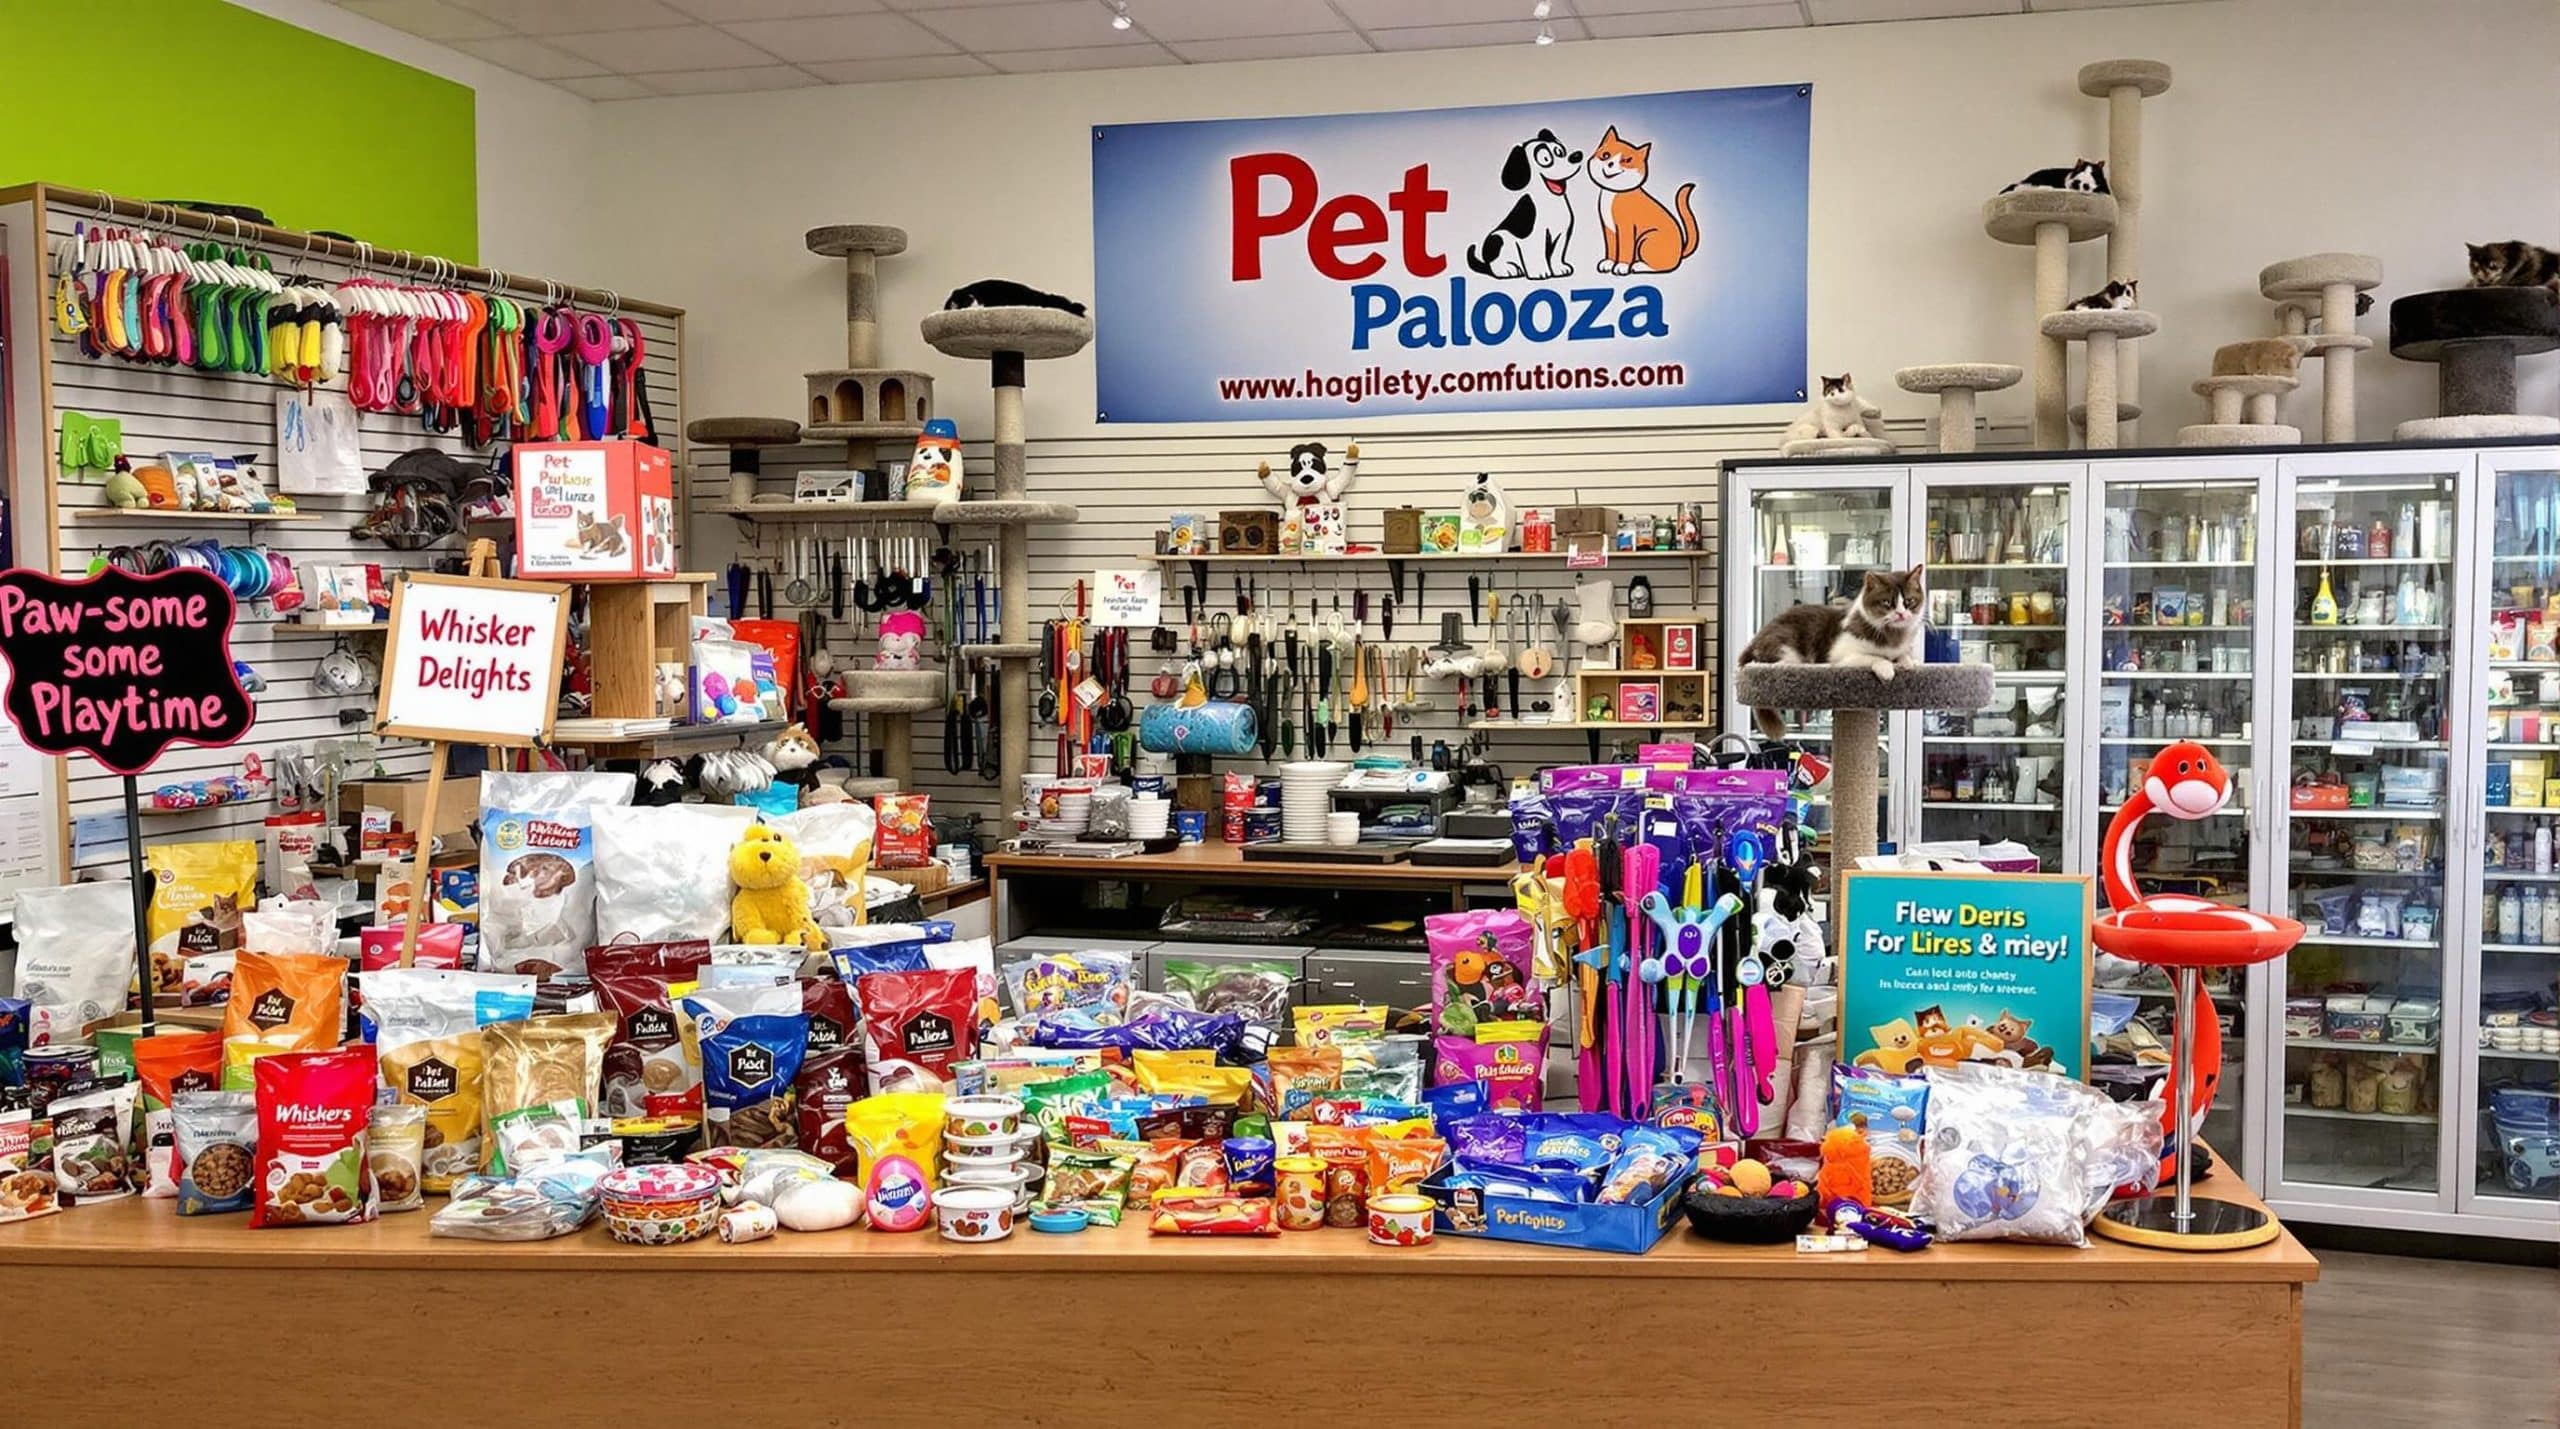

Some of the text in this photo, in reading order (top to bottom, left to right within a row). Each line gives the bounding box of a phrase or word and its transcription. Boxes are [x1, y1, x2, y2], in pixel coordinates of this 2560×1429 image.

[1230, 152, 1448, 281] Pet
[1351, 276, 1669, 350] Palooza
[0, 584, 208, 638] Paw-some
[421, 608, 536, 647] Whisker
[62, 644, 163, 678] some
[418, 655, 531, 700] Delights
[31, 681, 228, 746] Playtime
[1896, 901, 2026, 928] Flew Deris
[1865, 929, 1905, 953] For
[1911, 931, 1973, 955] Lires
[1978, 933, 1998, 956] &
[276, 1103, 353, 1122] Whiskers
